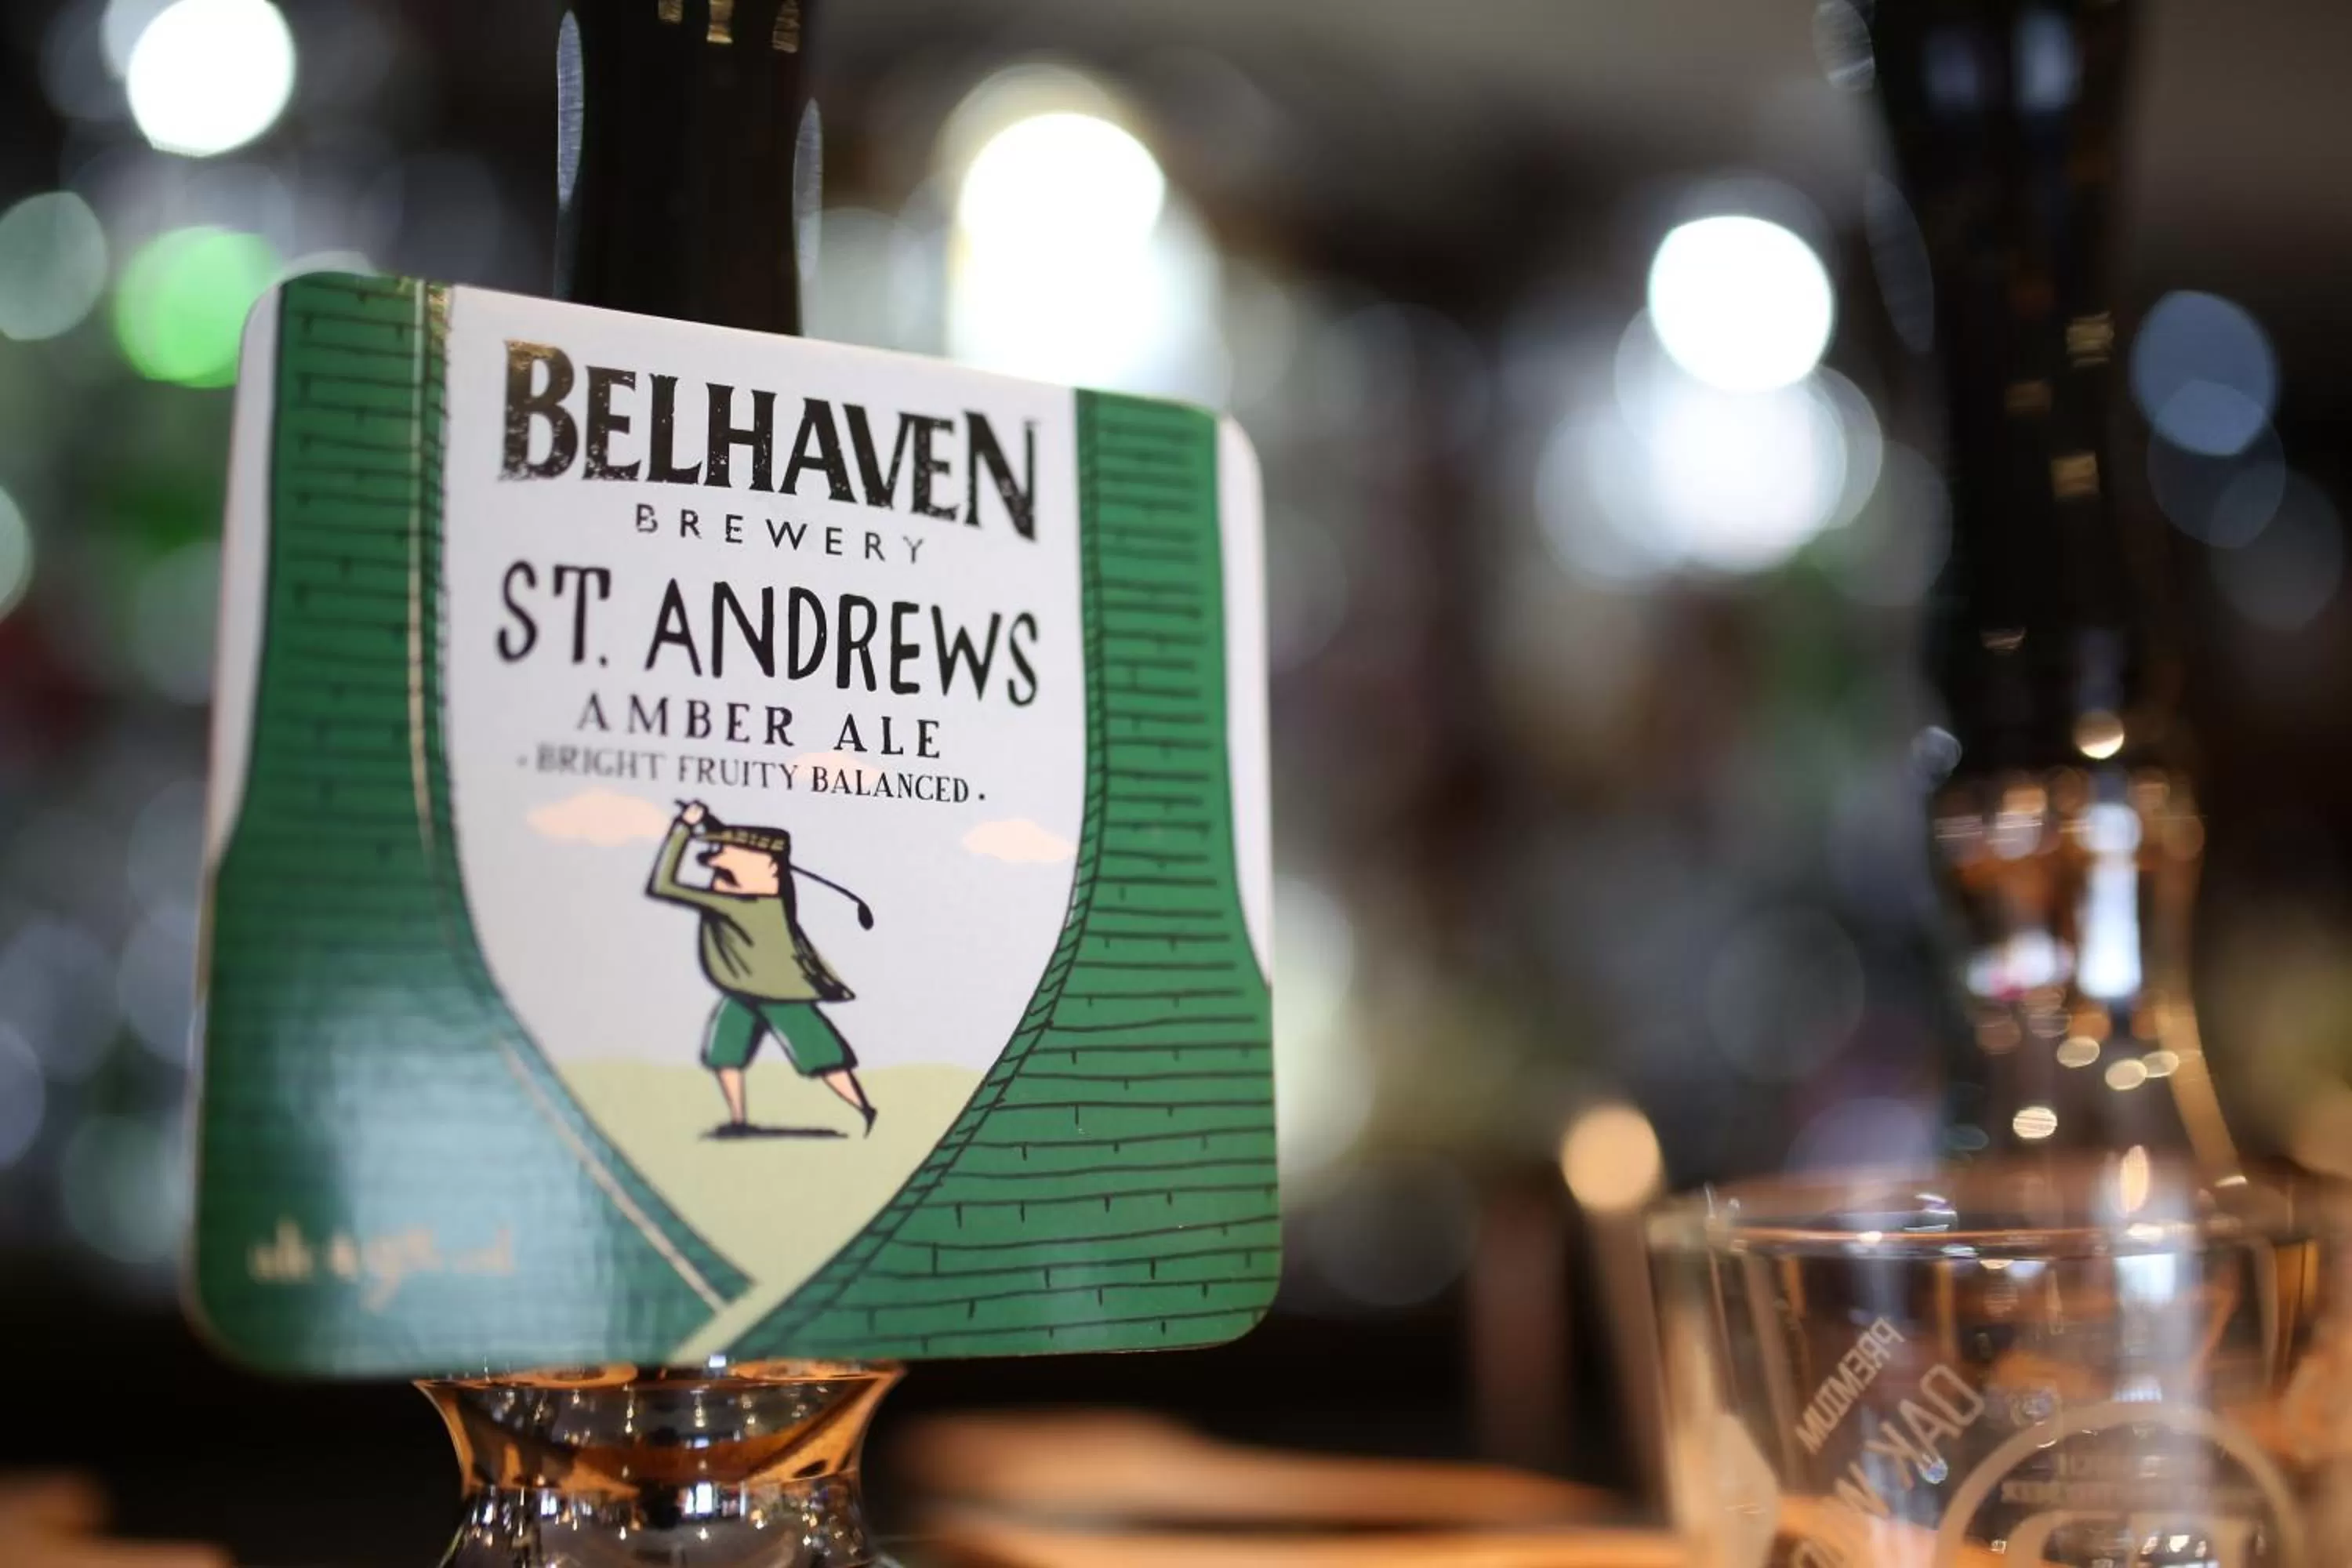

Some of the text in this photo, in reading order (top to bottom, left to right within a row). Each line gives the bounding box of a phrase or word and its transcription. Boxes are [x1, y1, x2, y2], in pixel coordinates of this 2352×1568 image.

[496, 339, 1040, 544] BELHAVEN
[635, 503, 924, 564] BREWERY
[495, 560, 1040, 708] ST. ANDREWS
[576, 689, 941, 759] AMBER ALE
[535, 742, 969, 804] BRIGHT FRUITY BALANCED
